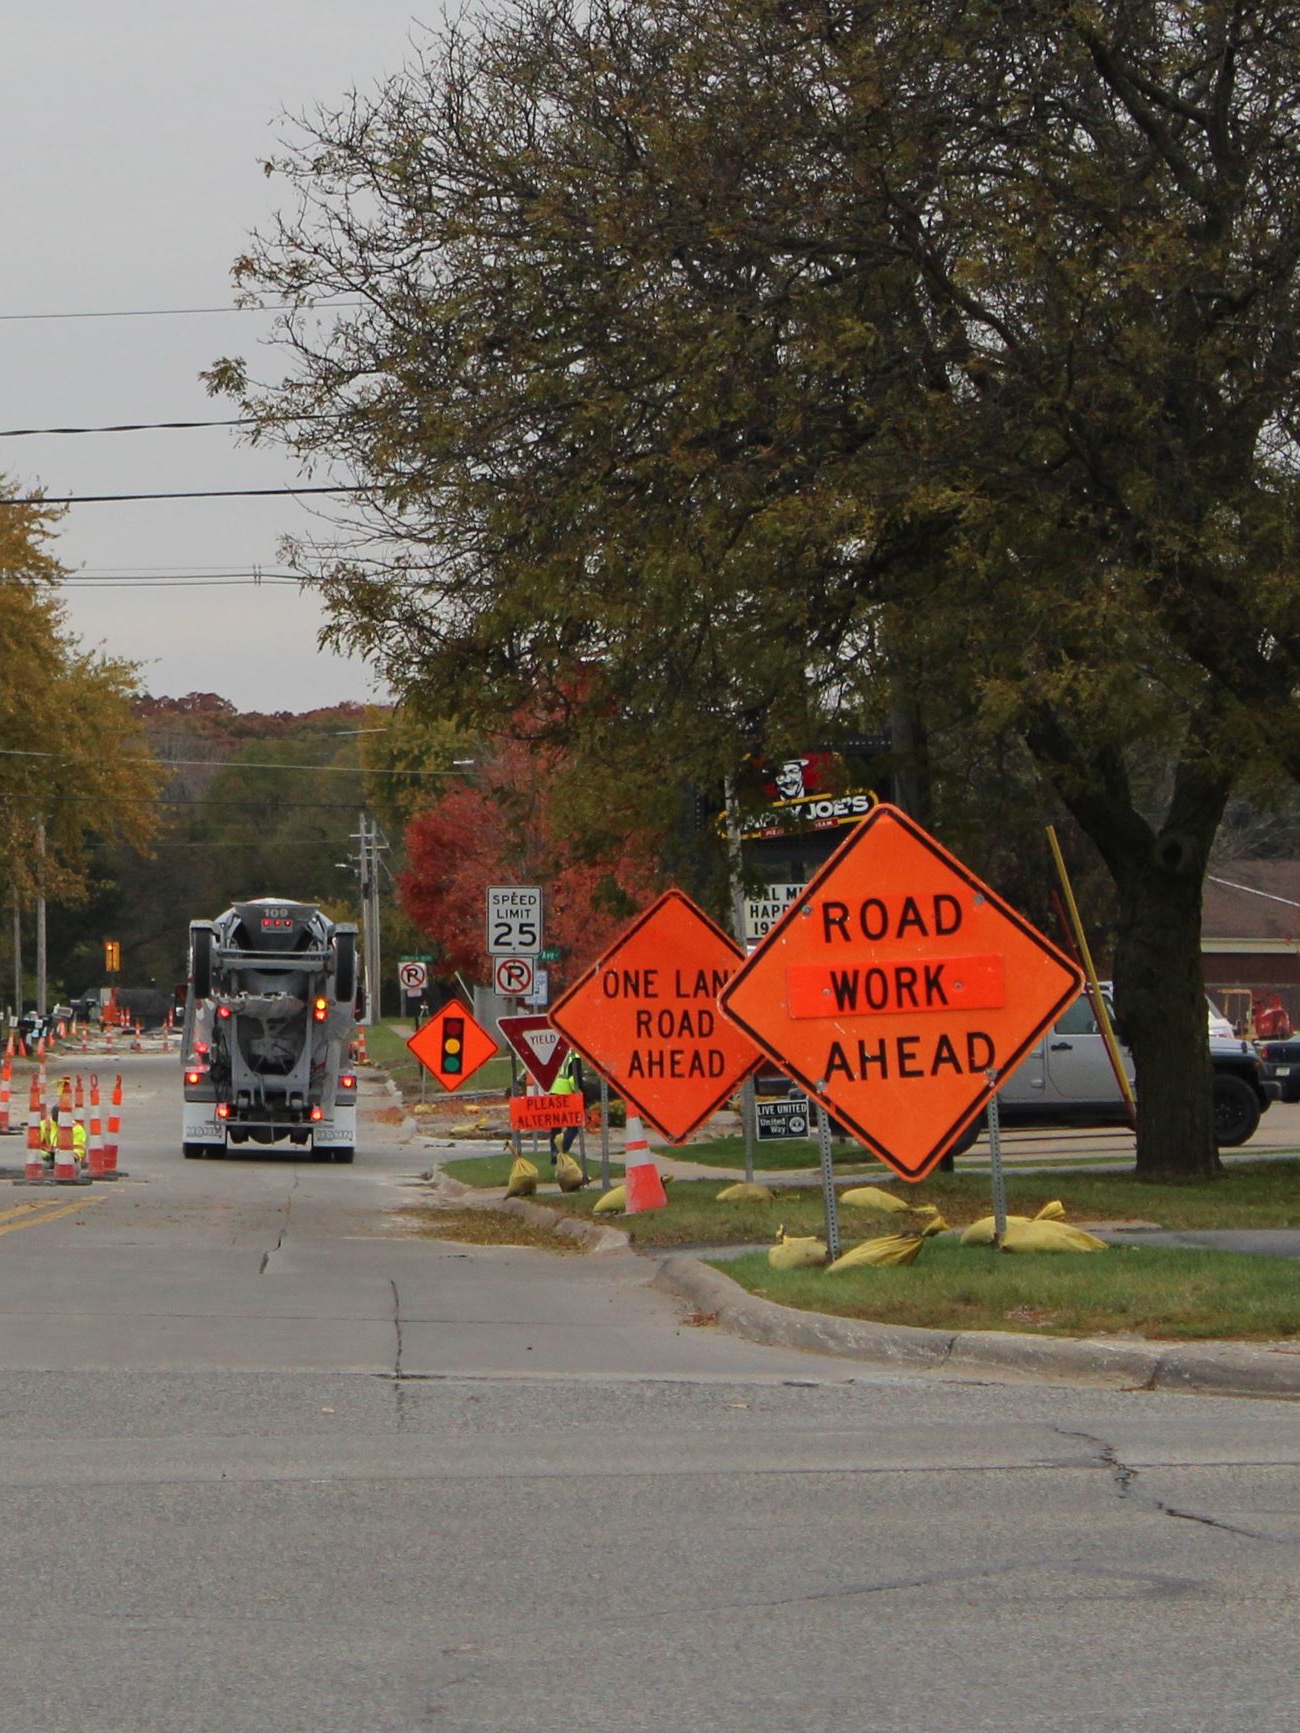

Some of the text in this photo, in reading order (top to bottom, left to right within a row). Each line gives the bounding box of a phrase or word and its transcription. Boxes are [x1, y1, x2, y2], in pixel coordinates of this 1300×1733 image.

[806, 795, 869, 820] JOE'S
[492, 894, 537, 906] SPEED
[496, 908, 531, 919] LIMIT
[822, 894, 963, 943] ROAD
[493, 922, 537, 947] 25
[754, 921, 776, 935] 19
[603, 969, 737, 998] ONE LAN
[830, 964, 949, 1012] WORK
[636, 1009, 715, 1038] ROAD
[530, 1034, 556, 1045] YIELD
[627, 1049, 725, 1078] AHEAD
[824, 1032, 996, 1082] AHEAD
[526, 1096, 570, 1111] PLEASE
[757, 1103, 807, 1115] LIVE UNITED
[518, 1112, 581, 1127] ALTERNATE
